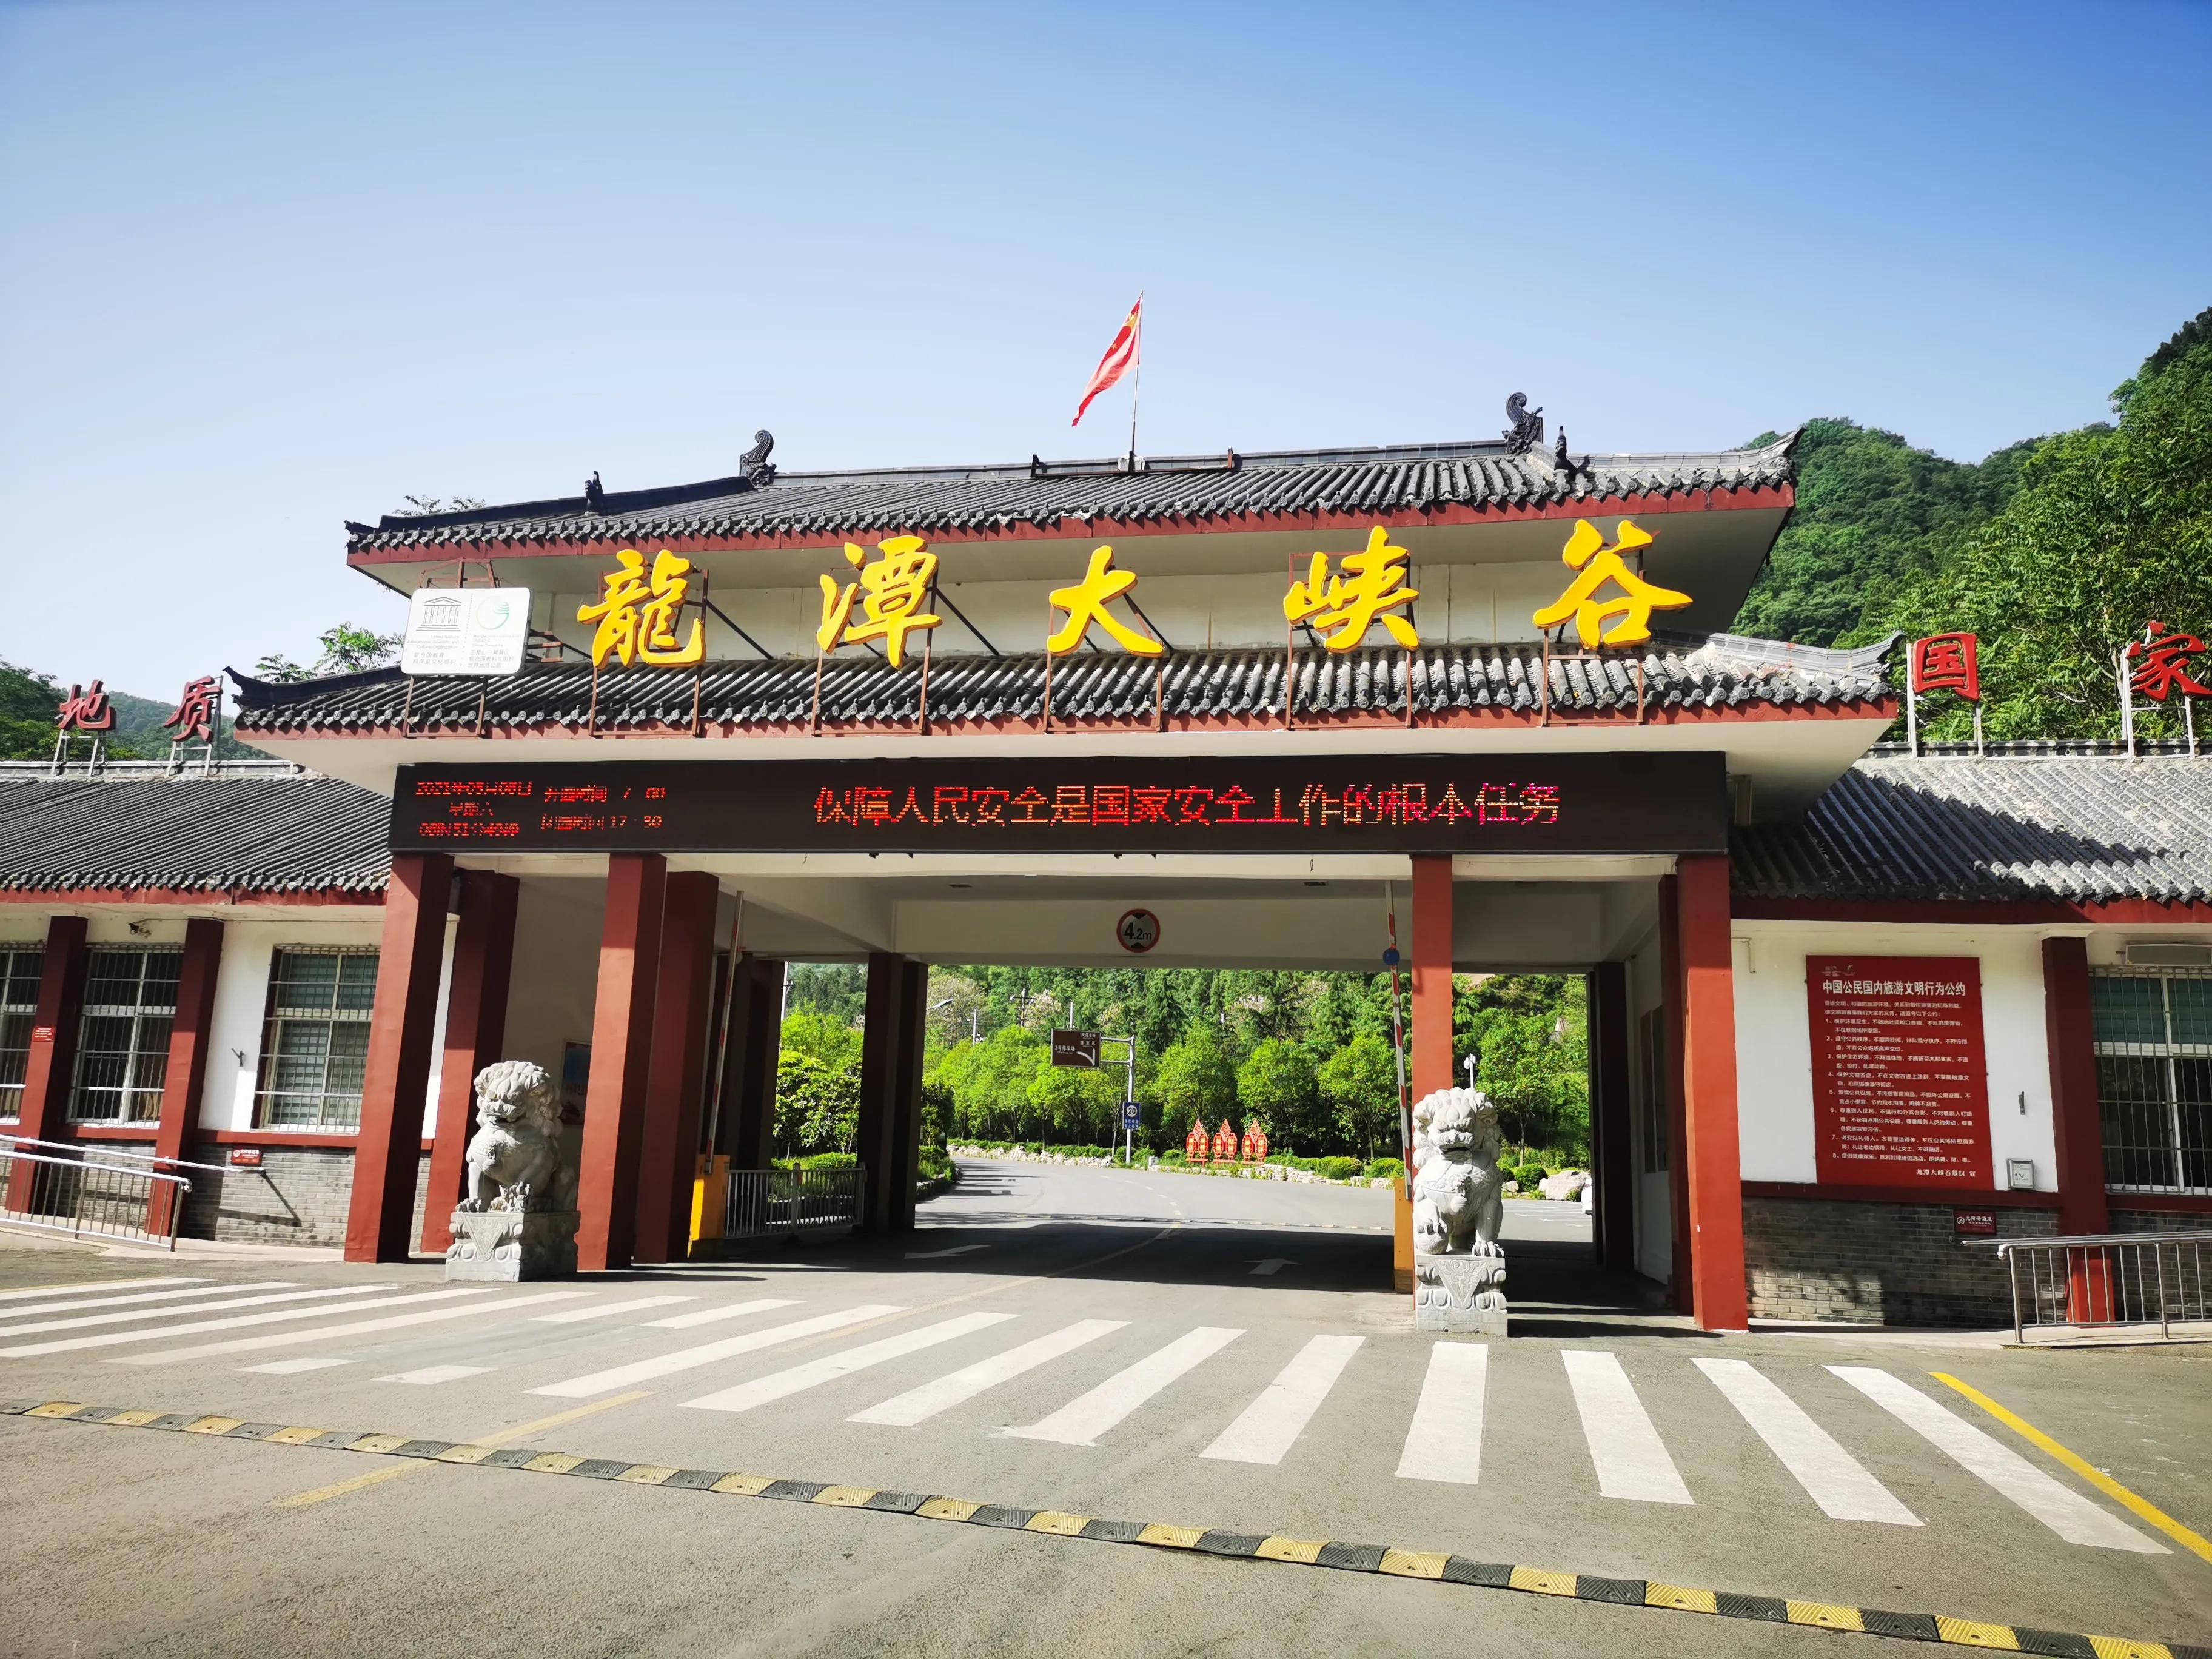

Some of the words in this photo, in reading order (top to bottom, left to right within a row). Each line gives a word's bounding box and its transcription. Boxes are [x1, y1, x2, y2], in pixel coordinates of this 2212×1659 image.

[577, 518, 1694, 669] 龍潭大峡谷
[423, 606, 459, 624] UNESCO
[58, 675, 223, 743] 地质
[1124, 922, 1151, 940] 4.2m
[1823, 979, 1966, 996] 中国公民国内旅游文明行为公约
